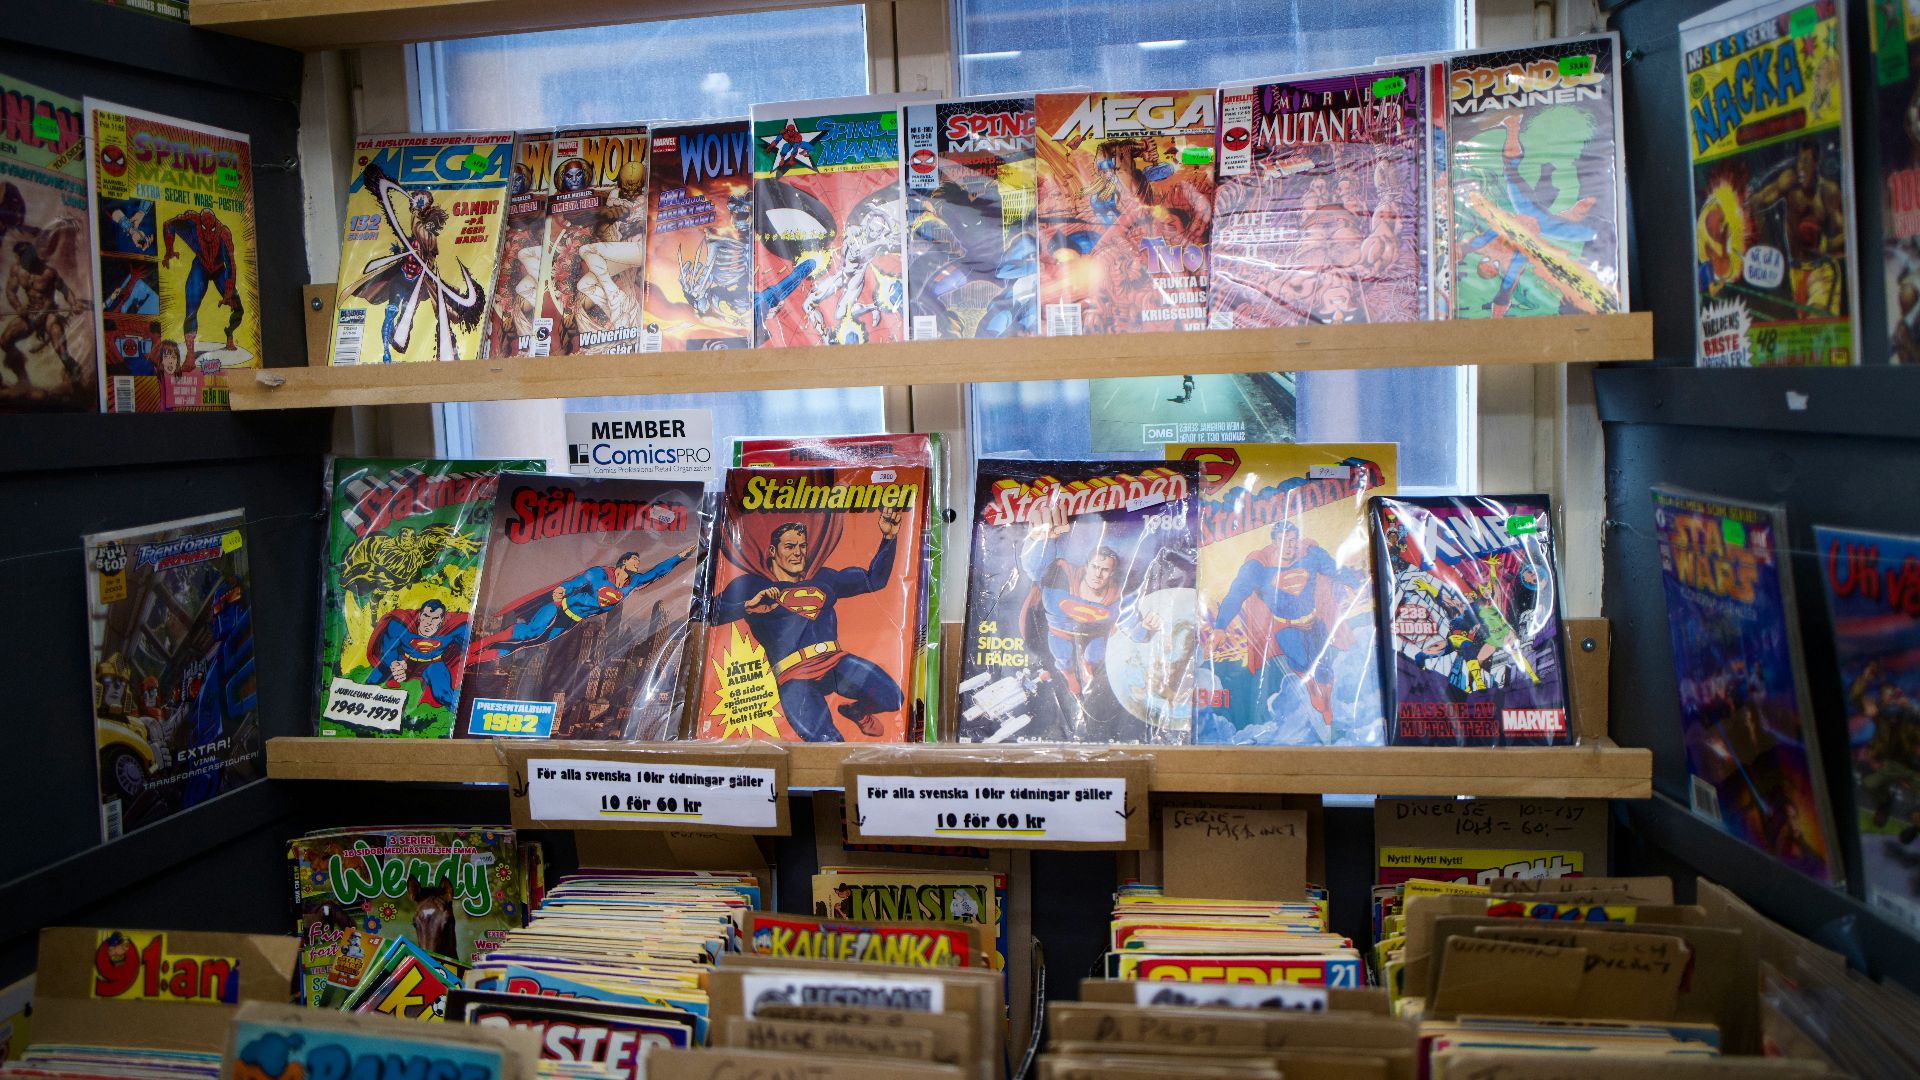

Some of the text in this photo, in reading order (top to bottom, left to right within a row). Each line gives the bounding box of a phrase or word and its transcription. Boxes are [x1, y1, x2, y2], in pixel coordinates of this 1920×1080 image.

[1451, 85, 1603, 115] MANNEN
[1690, 40, 1805, 155] NACKA
[1051, 94, 1215, 141] MEGA
[356, 140, 373, 149] TVÅ
[375, 137, 428, 148] AVSLUTADE
[430, 135, 512, 146] SUPER-ÄVENTYR!
[653, 137, 676, 146] MARVEL
[1106, 130, 1166, 138] MARVEL
[349, 143, 514, 194] MEGA
[136, 182, 161, 199] EXTRA
[165, 187, 190, 205] SECRET
[452, 200, 500, 216] GAMBIT
[350, 214, 382, 232] 132
[461, 226, 486, 235] EGEN
[579, 326, 638, 347] Wolverine
[591, 420, 687, 440] MEMBER
[592, 443, 711, 465] ComicsPRO
[593, 466, 617, 474] Comics
[617, 466, 654, 474] Professional
[674, 464, 713, 473] Organization
[743, 475, 919, 511] Stålmannen
[1143, 513, 1187, 531] 1980
[97, 542, 126, 560] Full
[1400, 608, 1427, 620] 238
[978, 621, 998, 635] 64
[1390, 622, 1438, 636] SIDOR!
[978, 636, 1025, 651] SIDOR
[986, 651, 1029, 667] FÄRG!
[726, 659, 764, 679] JÄTTE
[727, 672, 764, 687] ALBUM
[334, 687, 401, 705] JUBILEUMS-ÅRGÅNG
[724, 690, 774, 709] spännande
[729, 684, 766, 699] 68 sidor
[330, 699, 399, 722] 1949-1979
[477, 701, 552, 715] PRESENTALBUM
[731, 701, 768, 715] äventyr
[1400, 703, 1495, 719] MASSOR AV
[482, 714, 539, 733] 1982
[729, 714, 748, 726] helt
[754, 709, 773, 724] färg
[1503, 709, 1564, 731] MARVEL
[1400, 720, 1500, 738] MUTANTER!
[177, 736, 232, 762] EXTRA!
[193, 755, 216, 768] VINN
[143, 751, 260, 791] TRANSFORMERSFIGURER!
[537, 767, 764, 789] För alla svenska 10kr tidningar gäller
[867, 786, 1113, 802] För alla svenska 10kr tidningar gäller
[601, 794, 703, 813] 10 för 60 kr
[937, 813, 1046, 829] 10 för 60 kr
[390, 835, 436, 845] 3 SERIER!
[356, 848, 383, 857] SIDOR
[384, 847, 401, 855] MED
[1387, 854, 1463, 866] Nytt! Nytt! Nytt!
[329, 839, 493, 917] Wendy
[1331, 964, 1358, 989] 21
